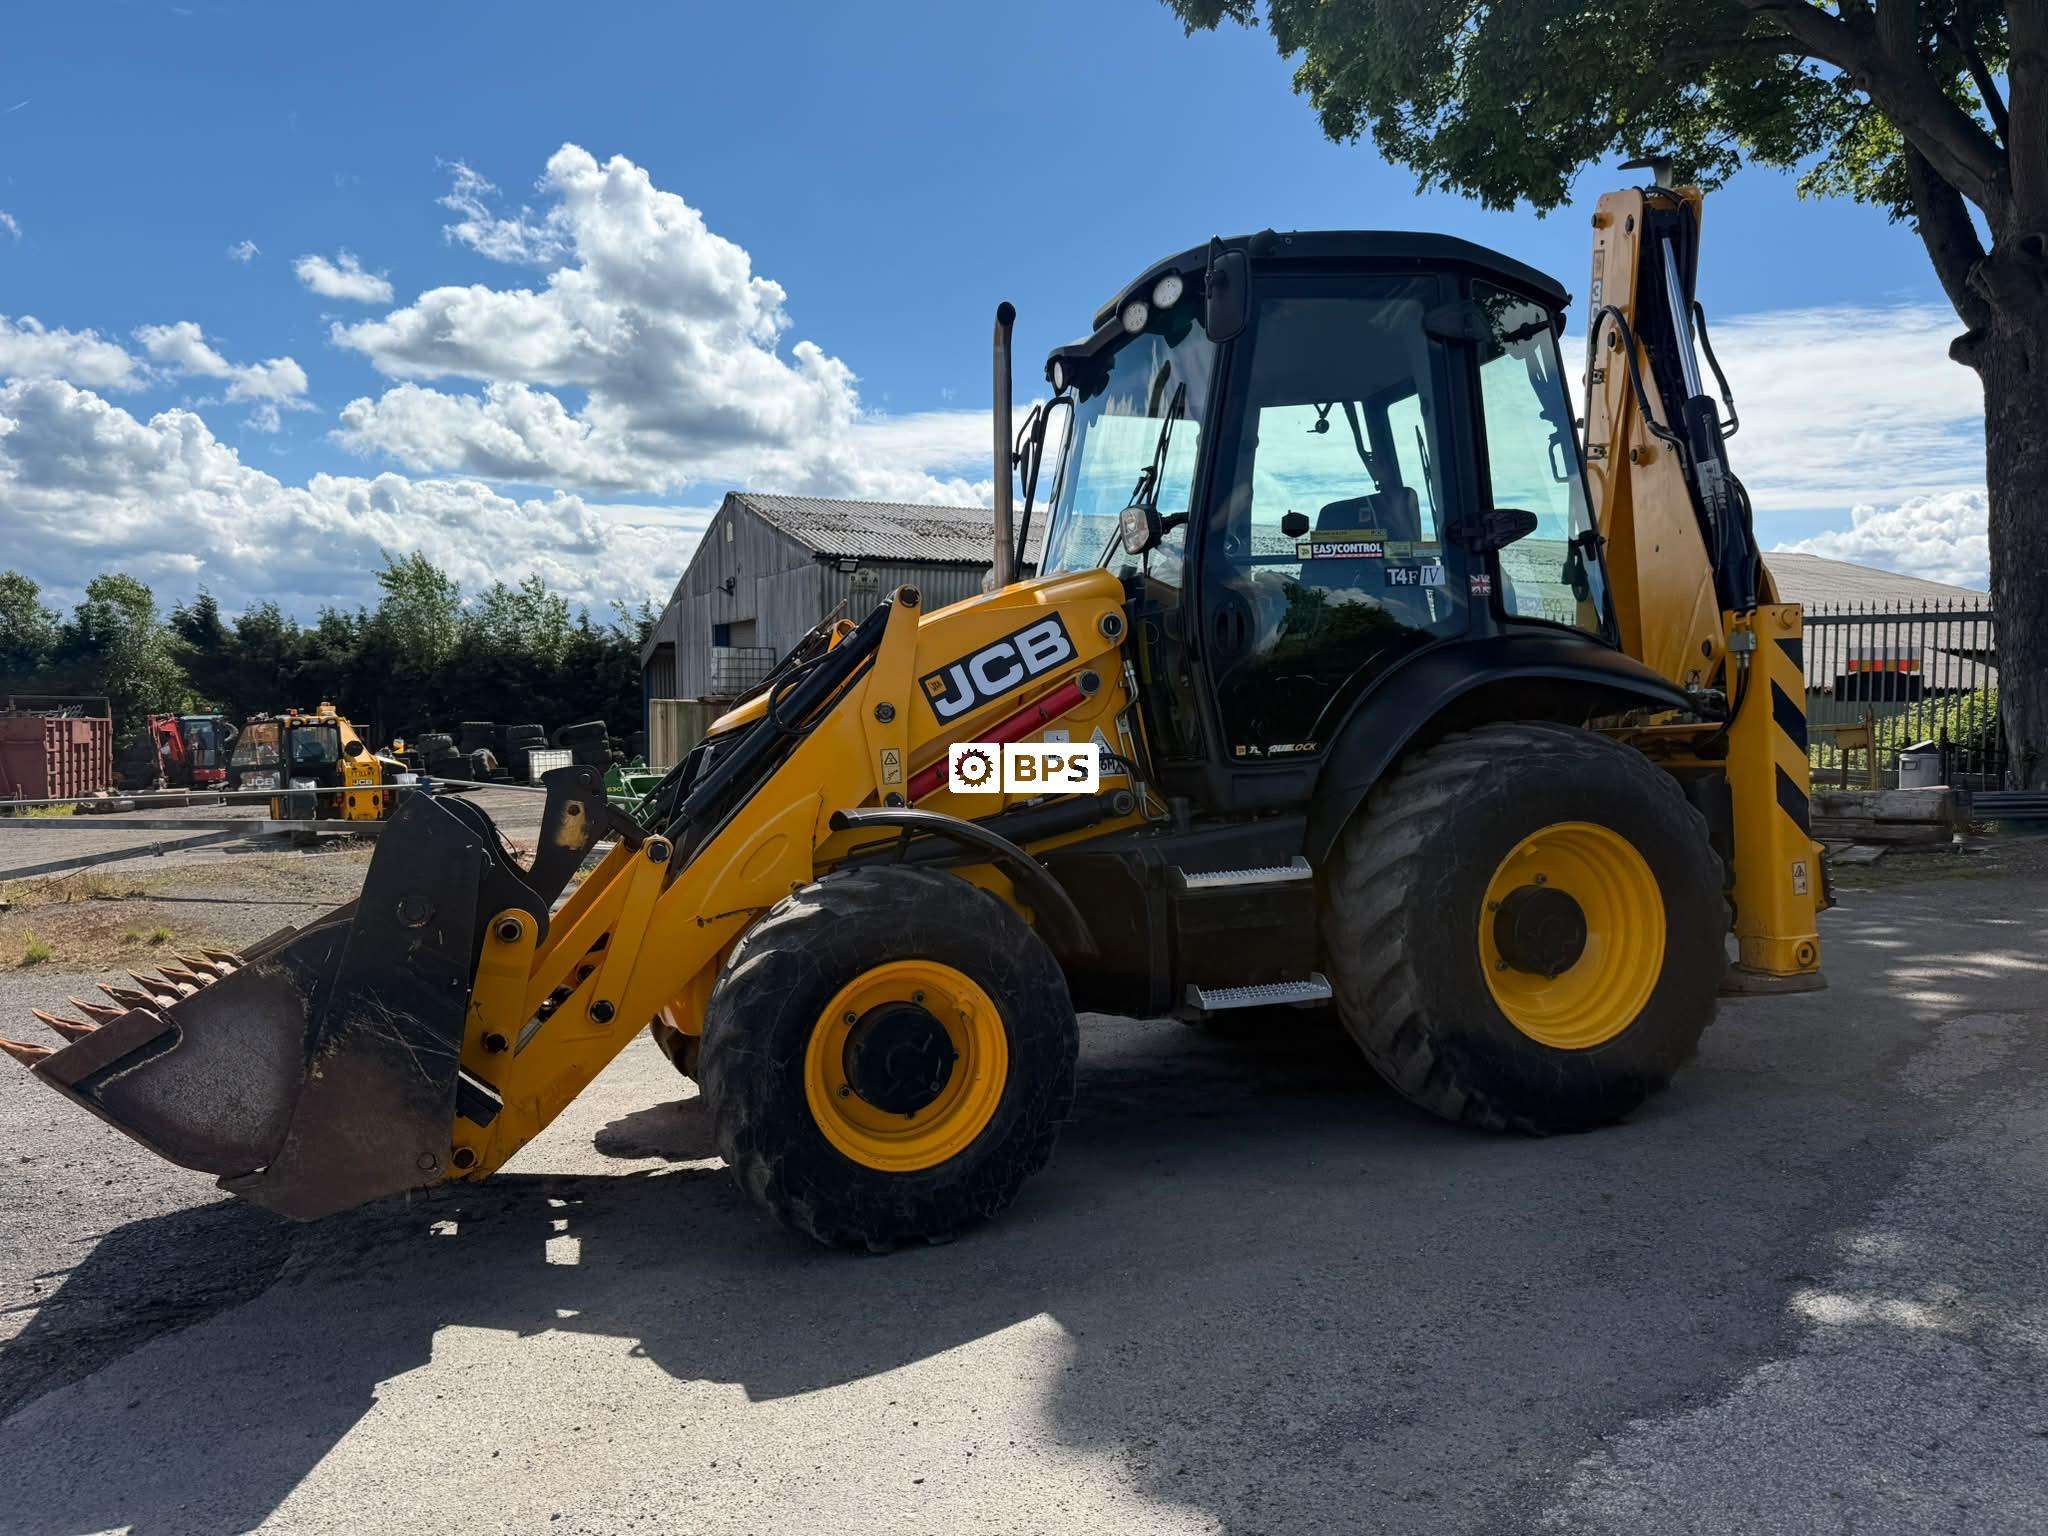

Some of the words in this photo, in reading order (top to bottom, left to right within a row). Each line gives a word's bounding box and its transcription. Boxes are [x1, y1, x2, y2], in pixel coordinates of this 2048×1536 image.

[1313, 543, 1382, 556] EASYCONTROL
[1387, 568, 1419, 585] T4F
[935, 621, 1071, 717] JCB
[246, 777, 274, 786] JCB
